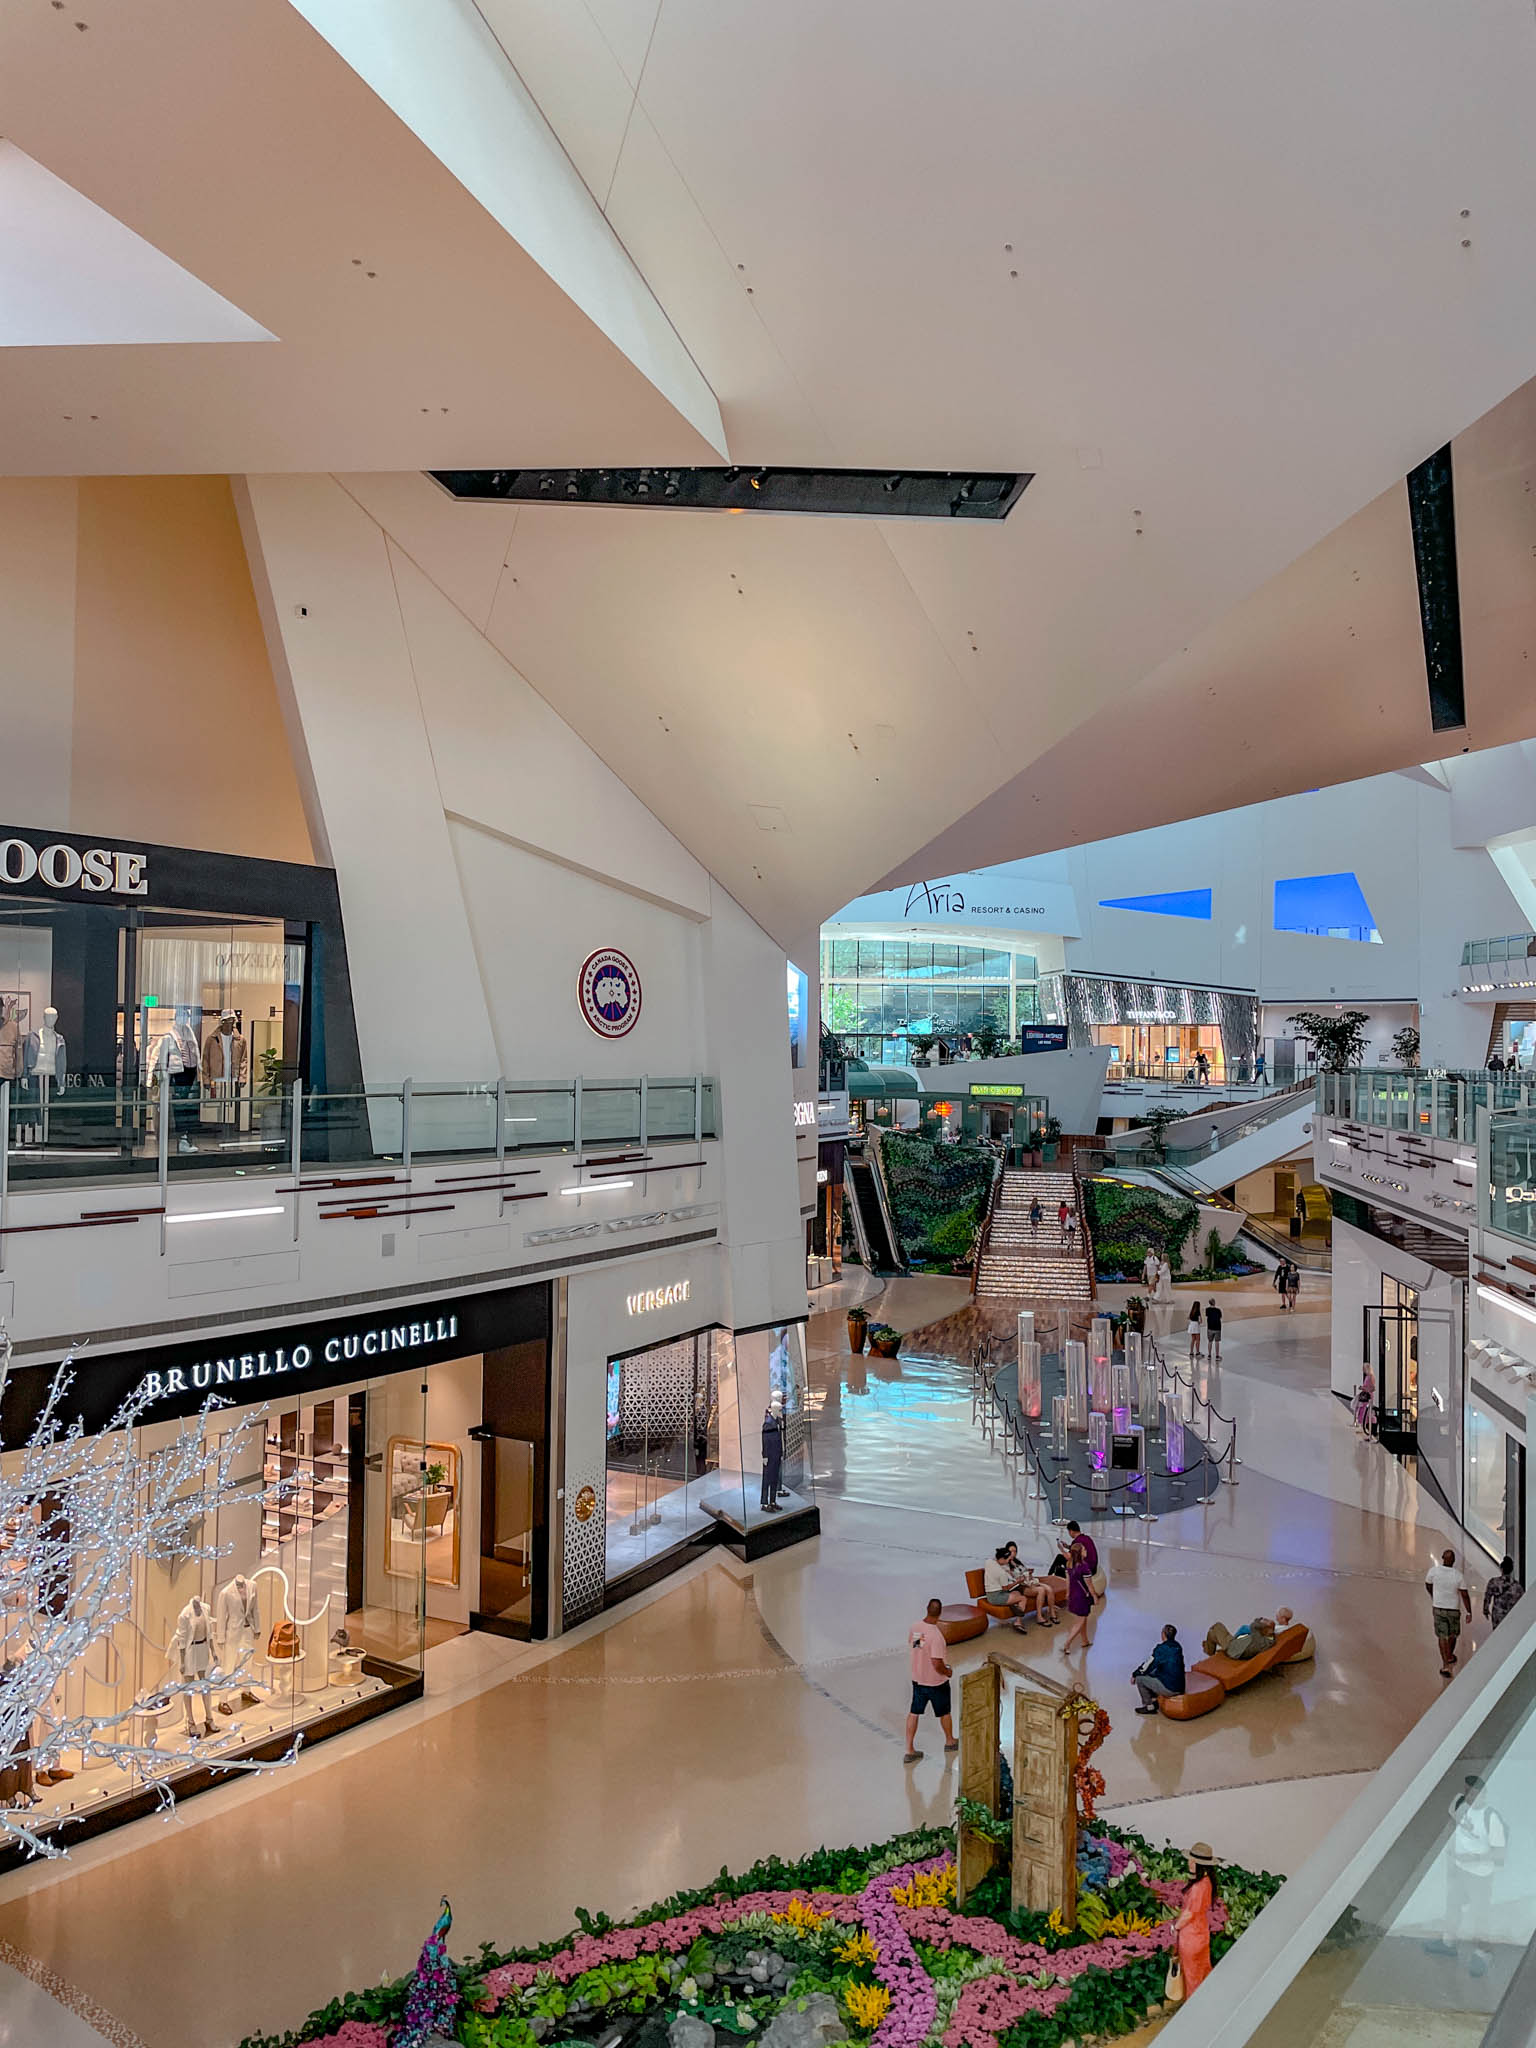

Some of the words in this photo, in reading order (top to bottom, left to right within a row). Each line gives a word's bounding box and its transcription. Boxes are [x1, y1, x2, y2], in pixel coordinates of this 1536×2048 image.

[0, 838, 149, 895] OOSE
[904, 881, 965, 917] Aria
[971, 906, 1003, 914] RESORT
[1005, 906, 1011, 914] &
[1013, 906, 1045, 914] CASINO
[591, 955, 611, 970] CANADA
[611, 956, 629, 971] GOOSE
[592, 1014, 611, 1031] ARCTIC
[611, 1013, 633, 1032] PROGRAM
[626, 1280, 692, 1316] VERSACE
[145, 1345, 312, 1398] BRUNELLO
[324, 1315, 458, 1362] CUCINELLI
